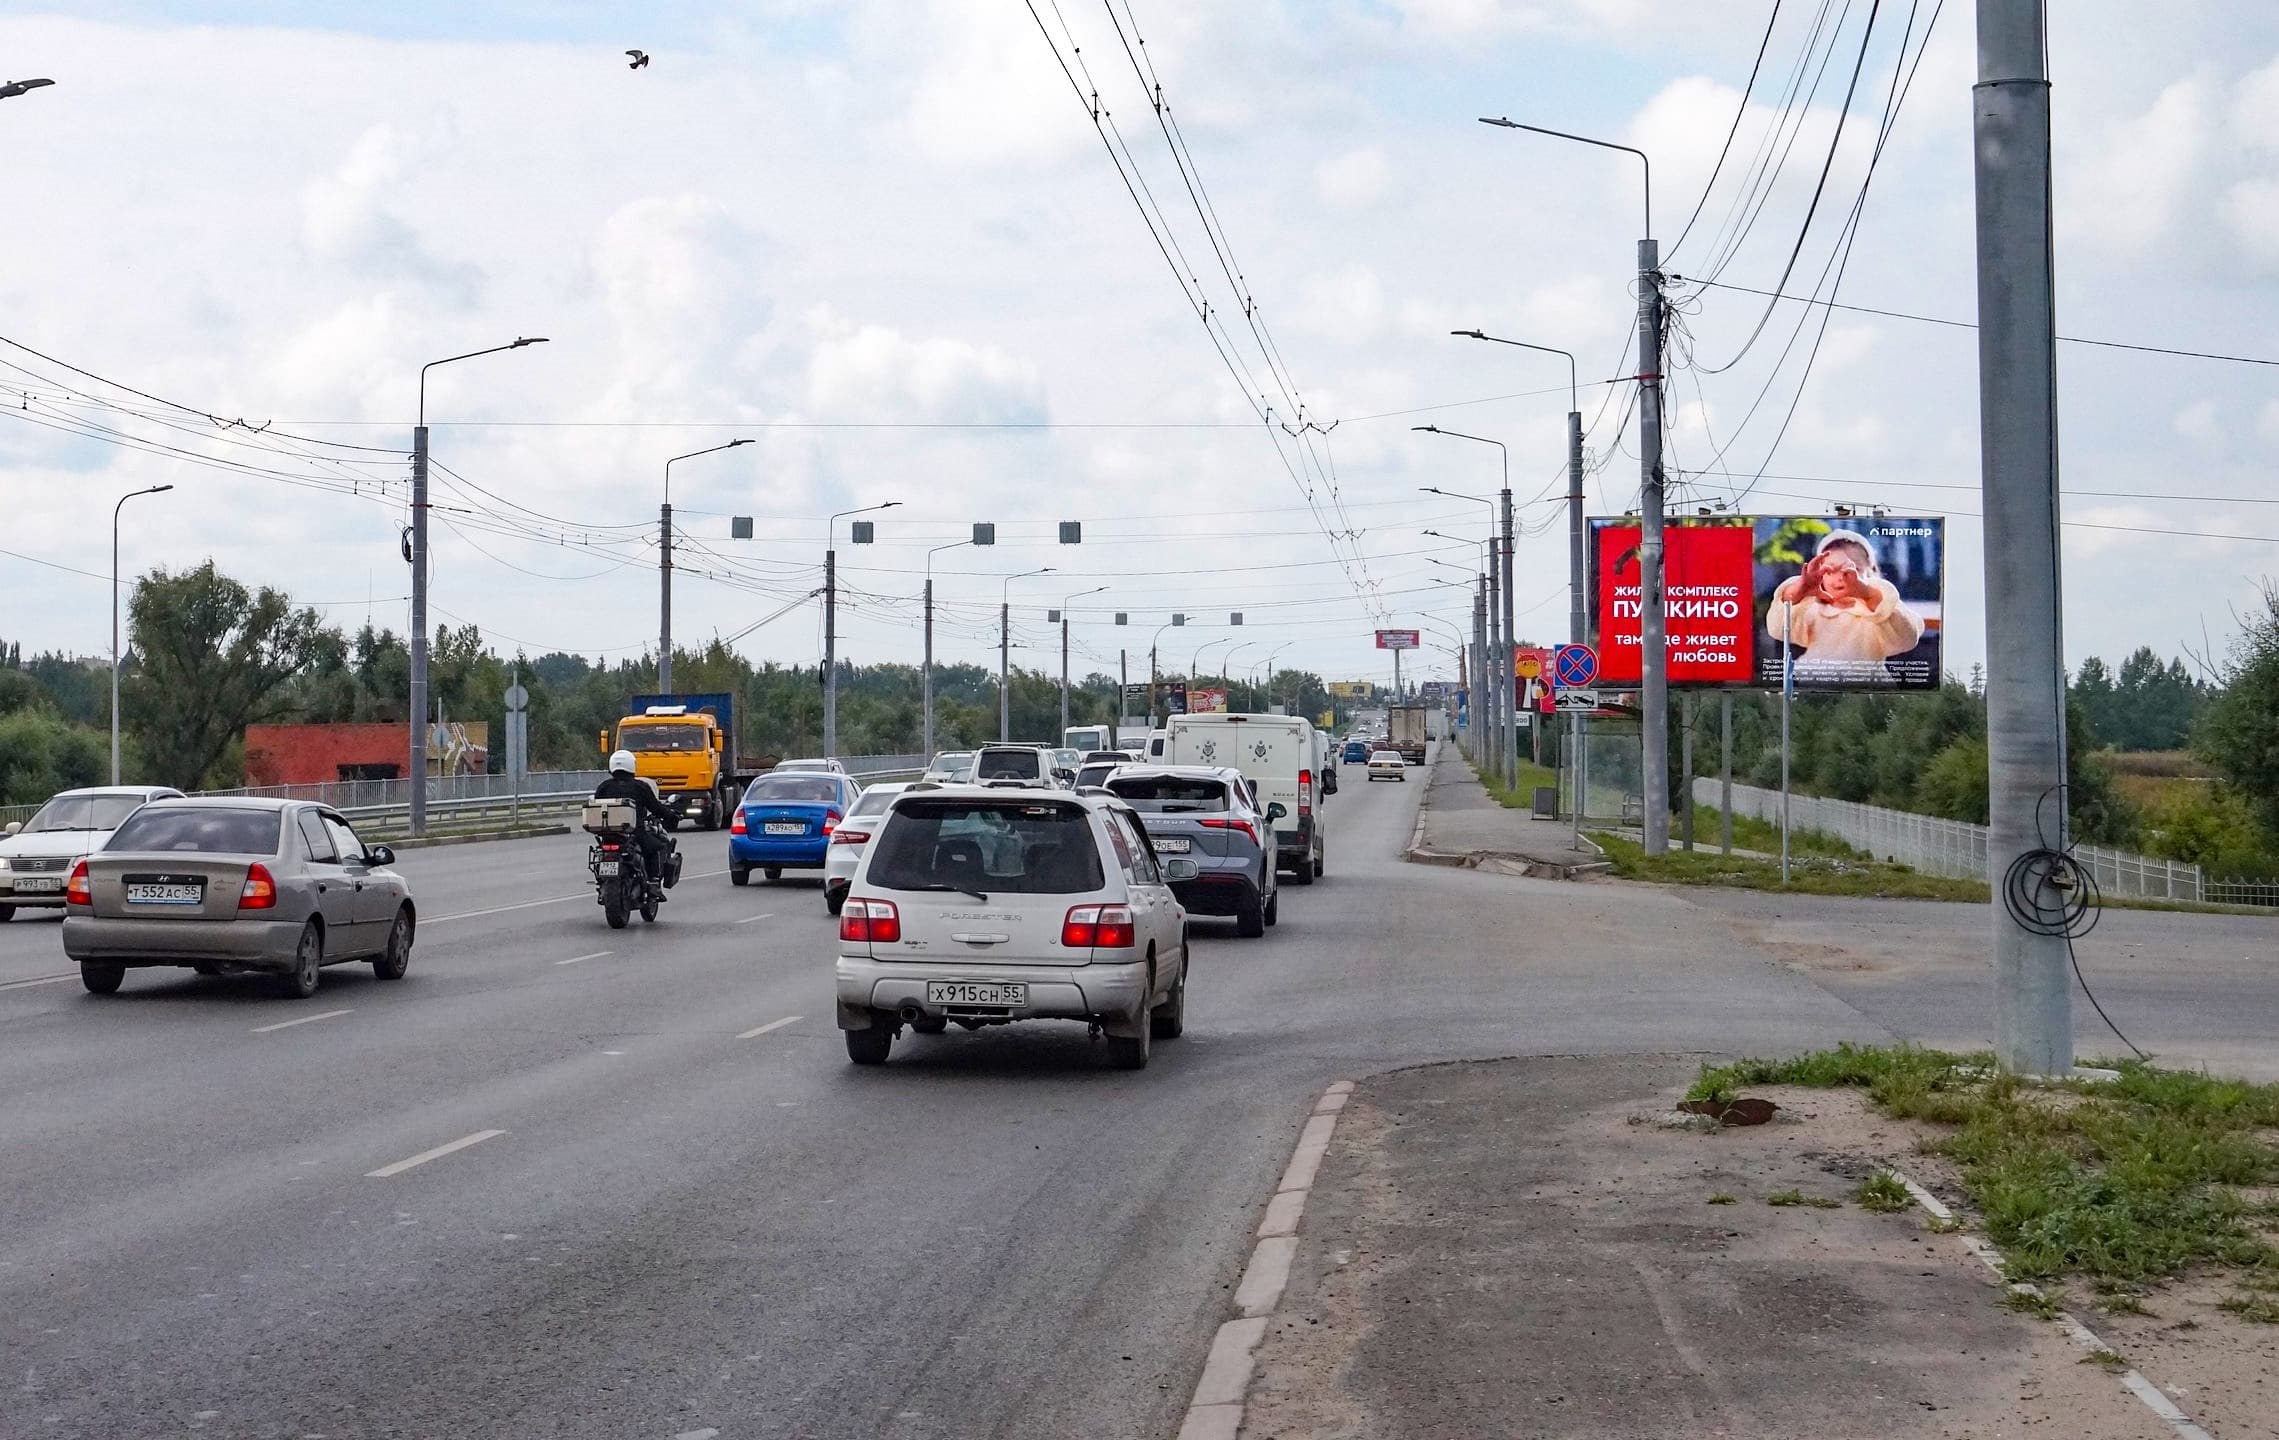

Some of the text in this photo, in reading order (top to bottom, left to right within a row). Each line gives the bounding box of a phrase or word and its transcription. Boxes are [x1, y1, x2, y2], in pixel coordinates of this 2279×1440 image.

[1881, 527, 1933, 538] партнер
[1667, 586, 1739, 597] КОМПЛЕКС
[1613, 600, 1739, 618] ПУКИНО
[1685, 634, 1737, 645] живет
[1673, 648, 1737, 663] любовь
[1003, 986, 1020, 998] 55
